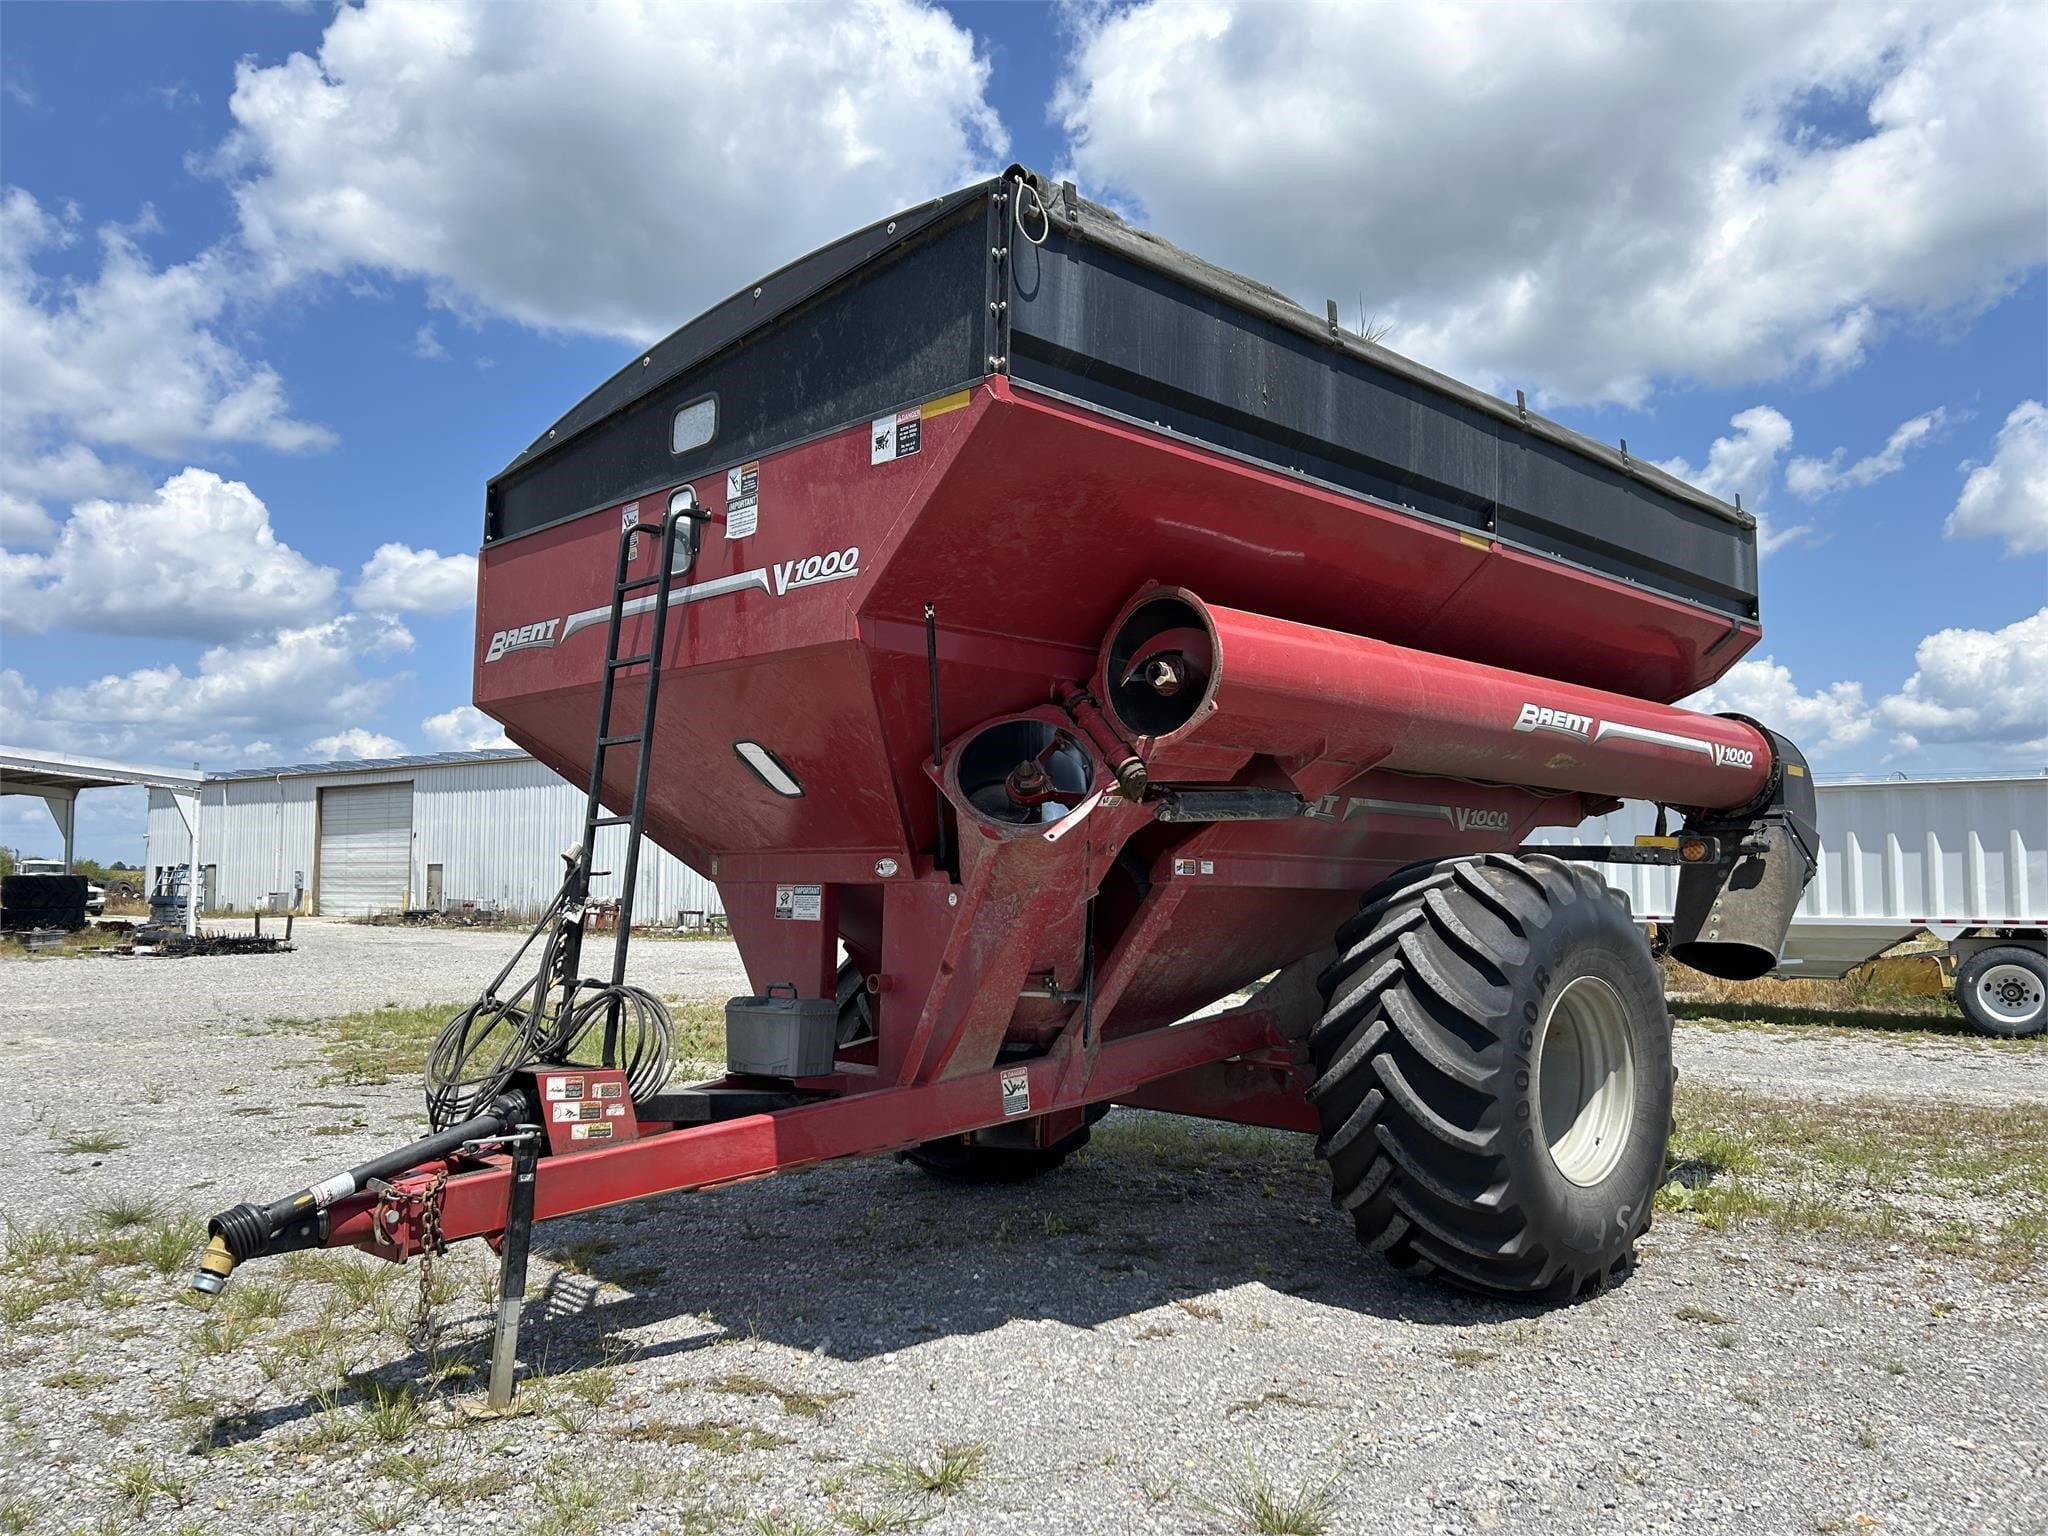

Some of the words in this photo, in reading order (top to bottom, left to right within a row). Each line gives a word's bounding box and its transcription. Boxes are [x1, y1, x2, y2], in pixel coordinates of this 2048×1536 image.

[729, 496, 756, 512] IMPORTANT
[485, 617, 560, 663] BRENT
[773, 546, 860, 596] V1000
[1512, 702, 1593, 734] BRENT
[1714, 742, 1753, 767] V1000
[1456, 806, 1508, 832] V1000
